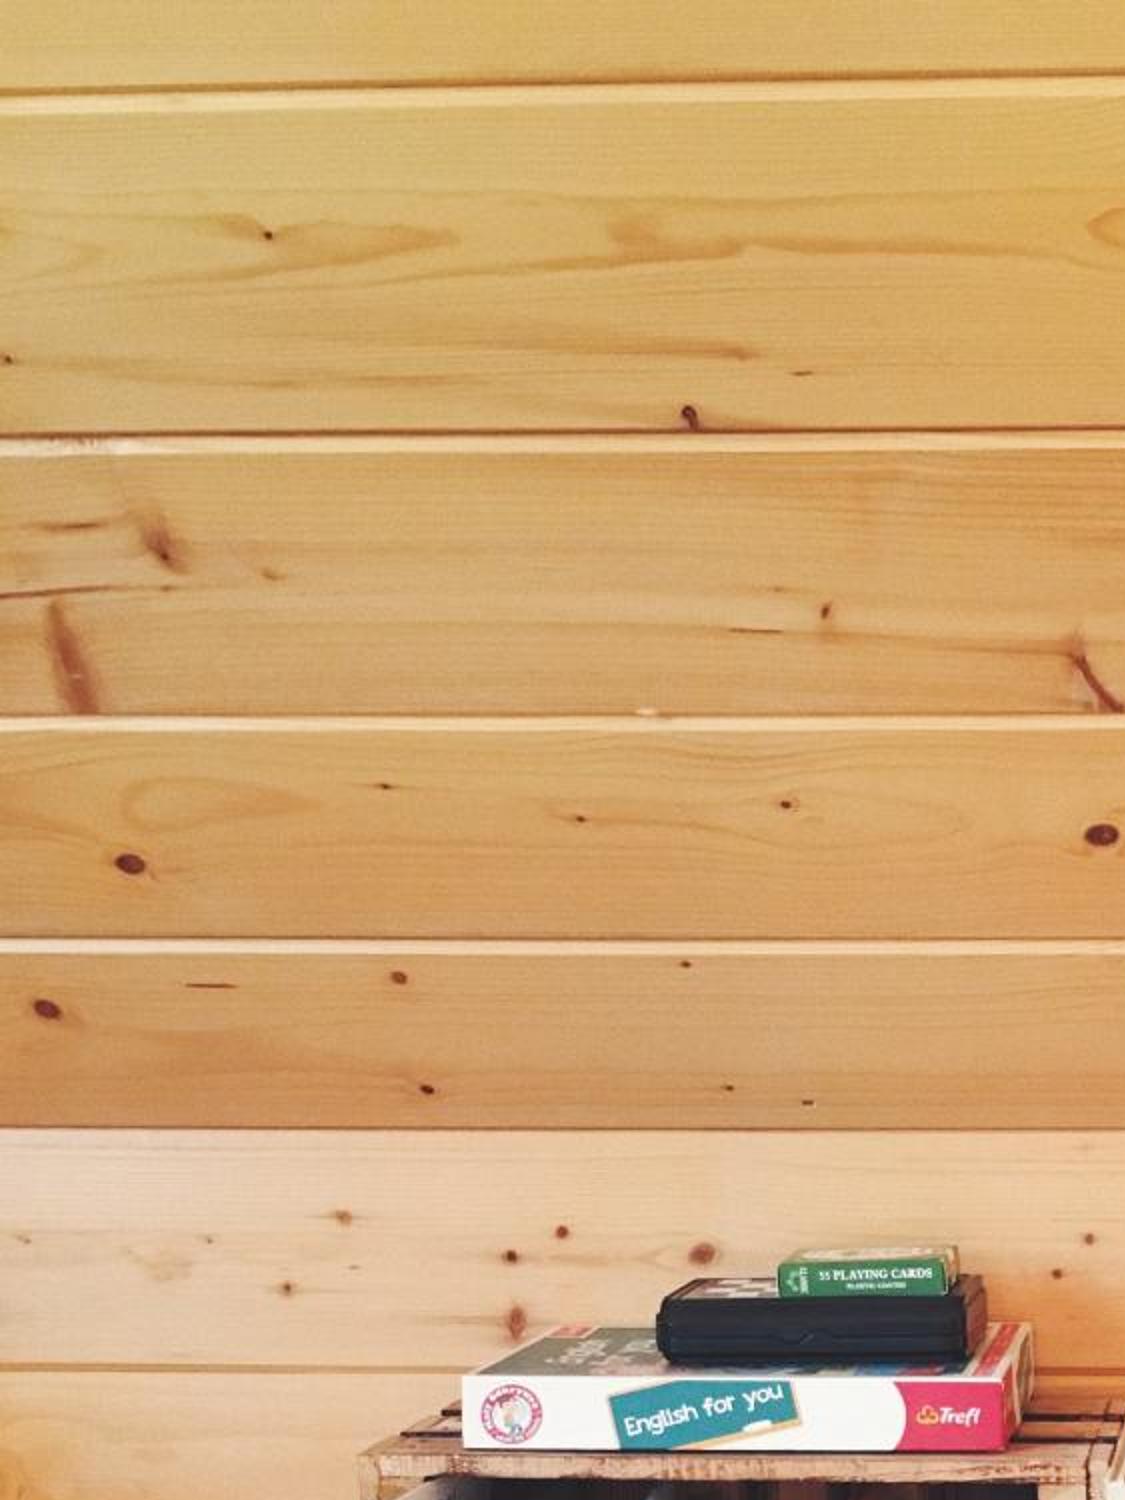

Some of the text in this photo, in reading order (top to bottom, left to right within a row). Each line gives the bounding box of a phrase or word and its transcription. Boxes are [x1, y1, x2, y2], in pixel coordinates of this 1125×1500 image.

[832, 1269, 889, 1281] PLAYING
[891, 1267, 933, 1280] CARDS
[624, 1384, 784, 1436] English for you
[940, 1407, 982, 1427] Trefl
